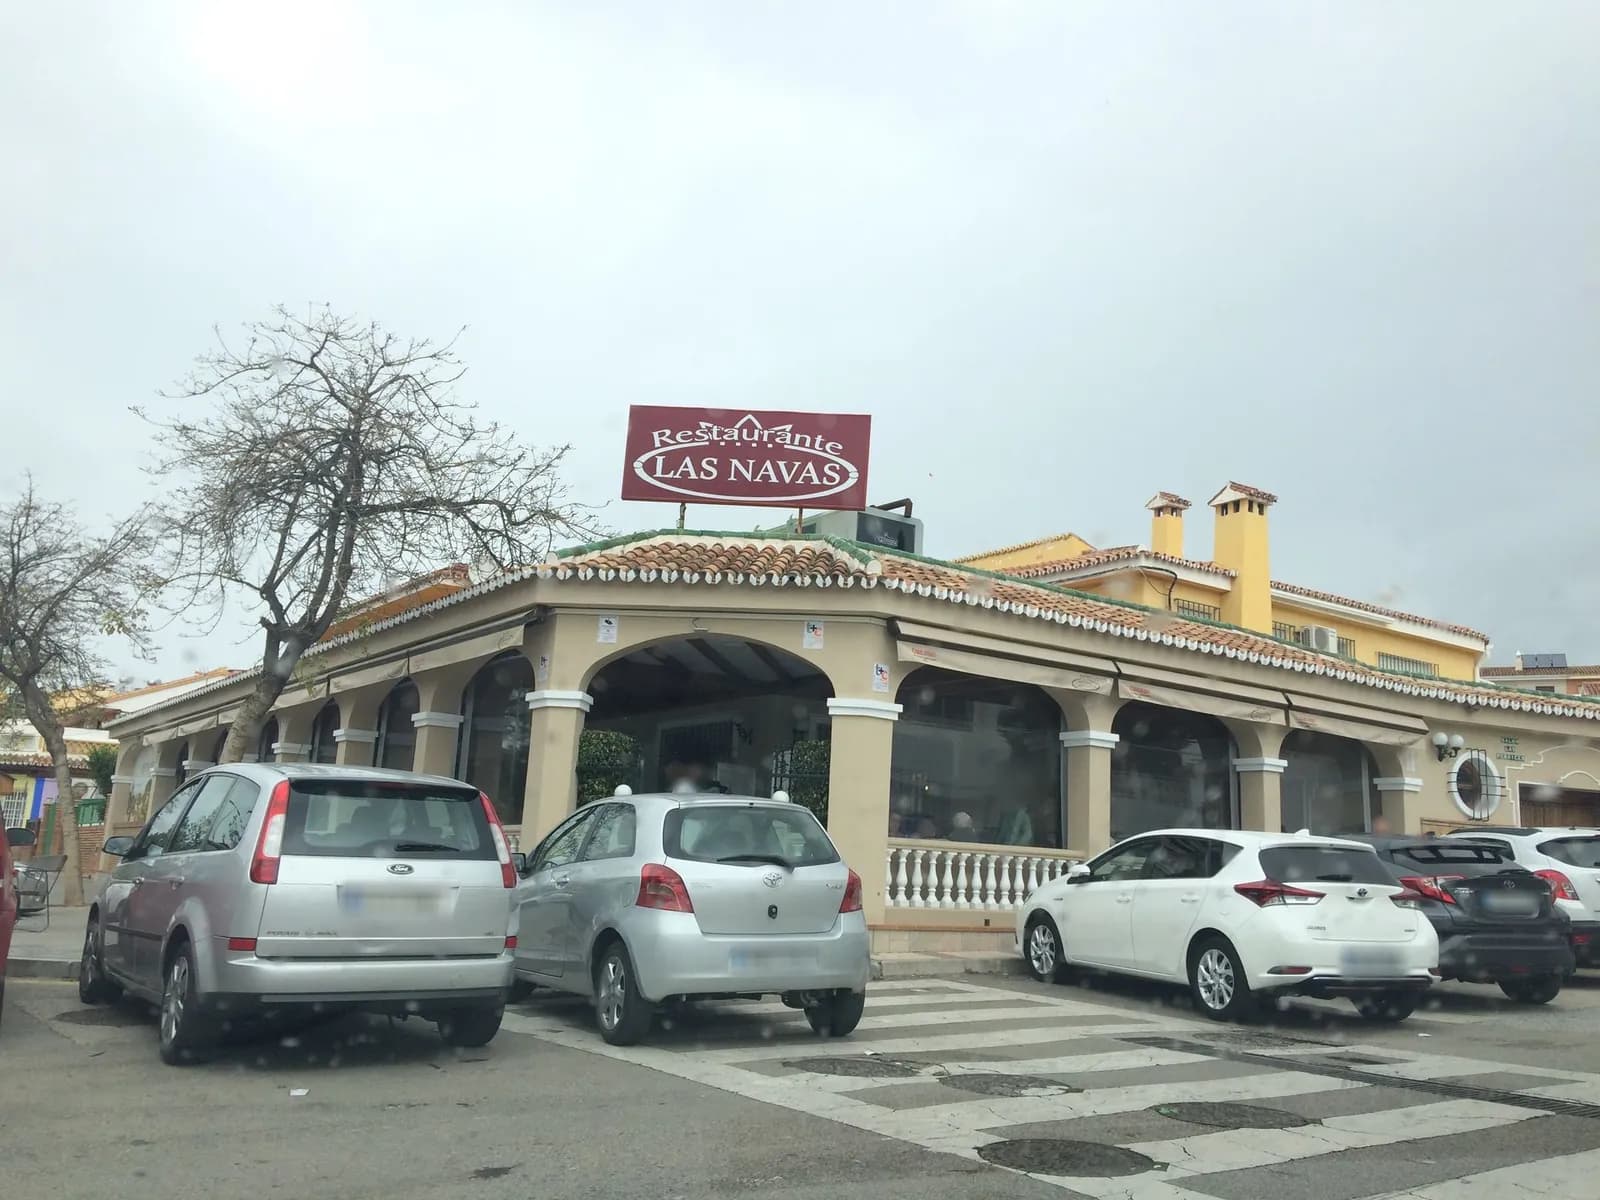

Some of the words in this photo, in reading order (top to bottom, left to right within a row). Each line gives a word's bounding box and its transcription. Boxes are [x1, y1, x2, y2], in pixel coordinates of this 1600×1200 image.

[652, 426, 843, 455] Restaurante
[654, 456, 718, 480] LAS
[728, 459, 841, 485] NAVAS
